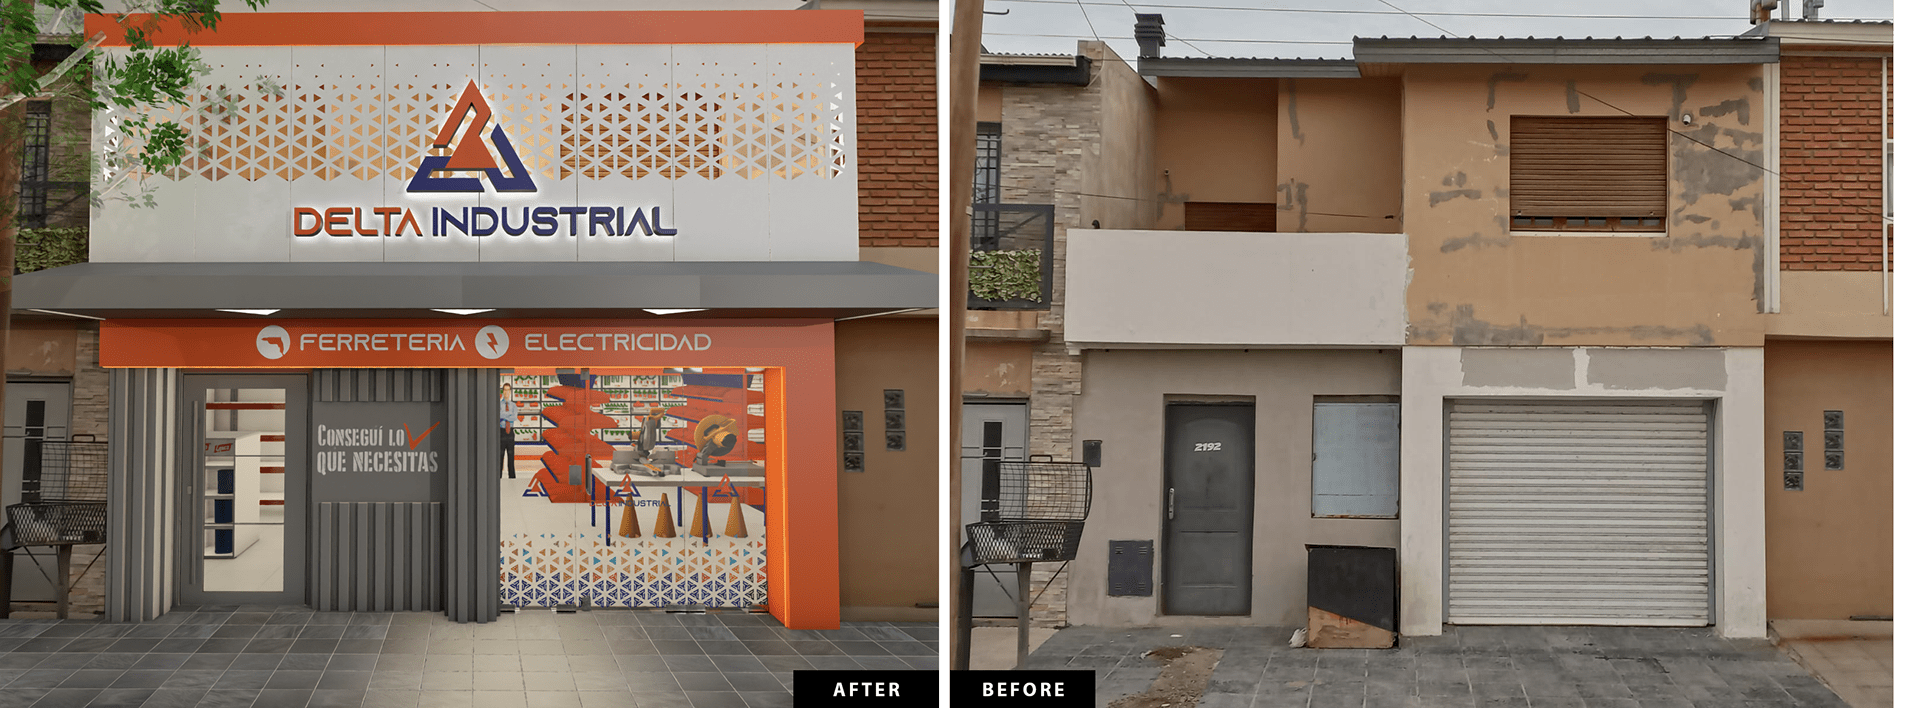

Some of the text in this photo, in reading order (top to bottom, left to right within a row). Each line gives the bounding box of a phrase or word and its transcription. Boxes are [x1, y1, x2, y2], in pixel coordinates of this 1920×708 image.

[294, 206, 678, 237] DELTA INDUSTRIAL
[300, 333, 711, 351] FERRETERIA ELECTRICIDAD
[1194, 442, 1222, 452] 2192
[316, 451, 439, 476] QUE NECESITAS
[618, 499, 671, 507] INDUSTRIAL
